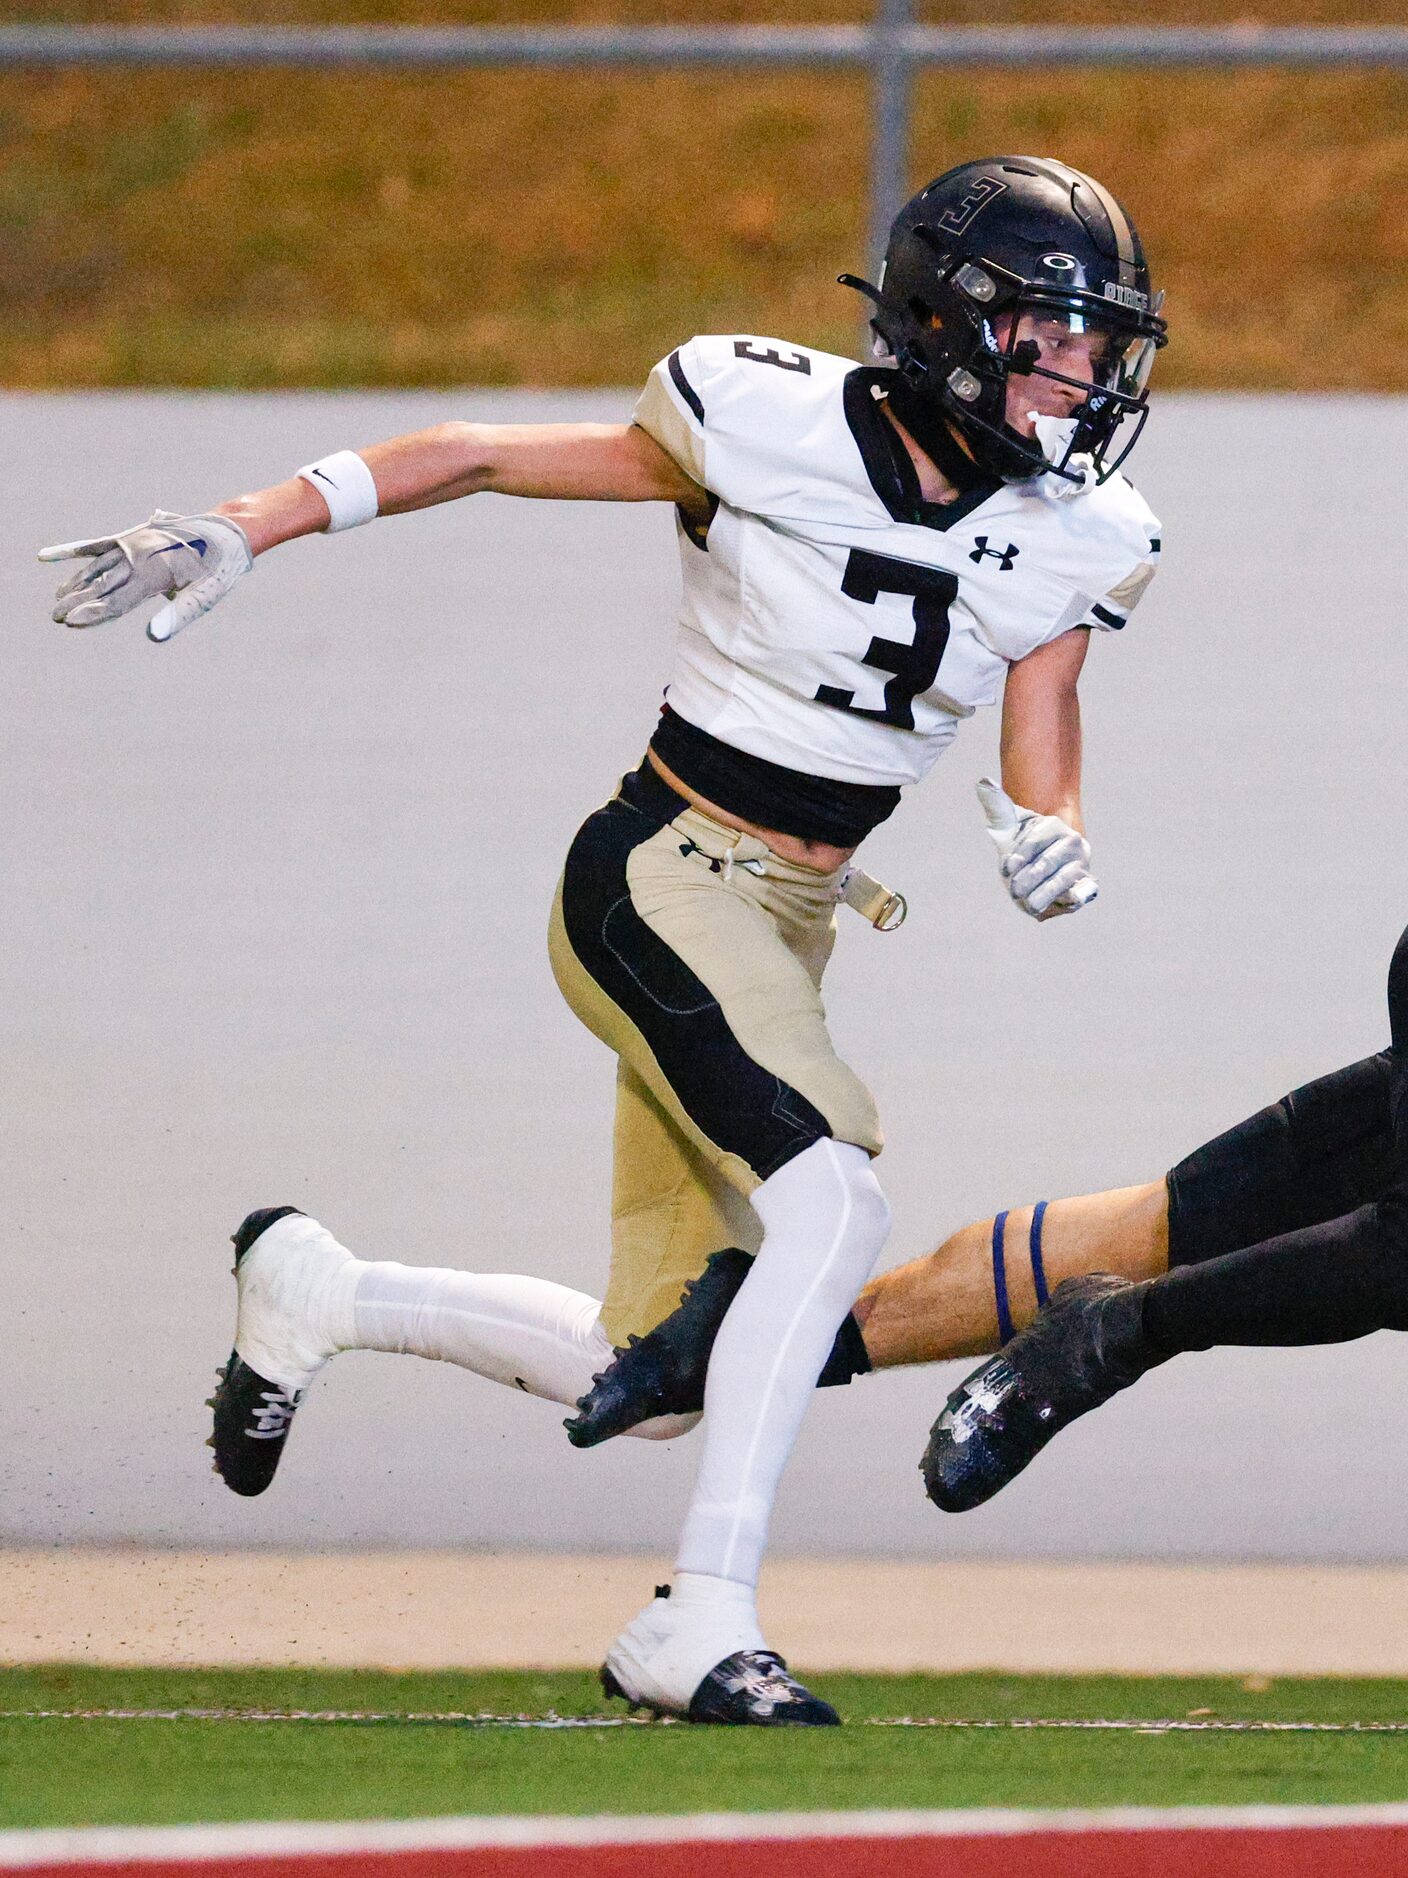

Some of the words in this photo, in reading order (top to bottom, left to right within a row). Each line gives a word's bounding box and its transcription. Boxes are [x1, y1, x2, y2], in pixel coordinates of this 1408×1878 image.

[938, 176, 1007, 236] 3
[733, 341, 811, 376] 3
[814, 546, 959, 731] 3
